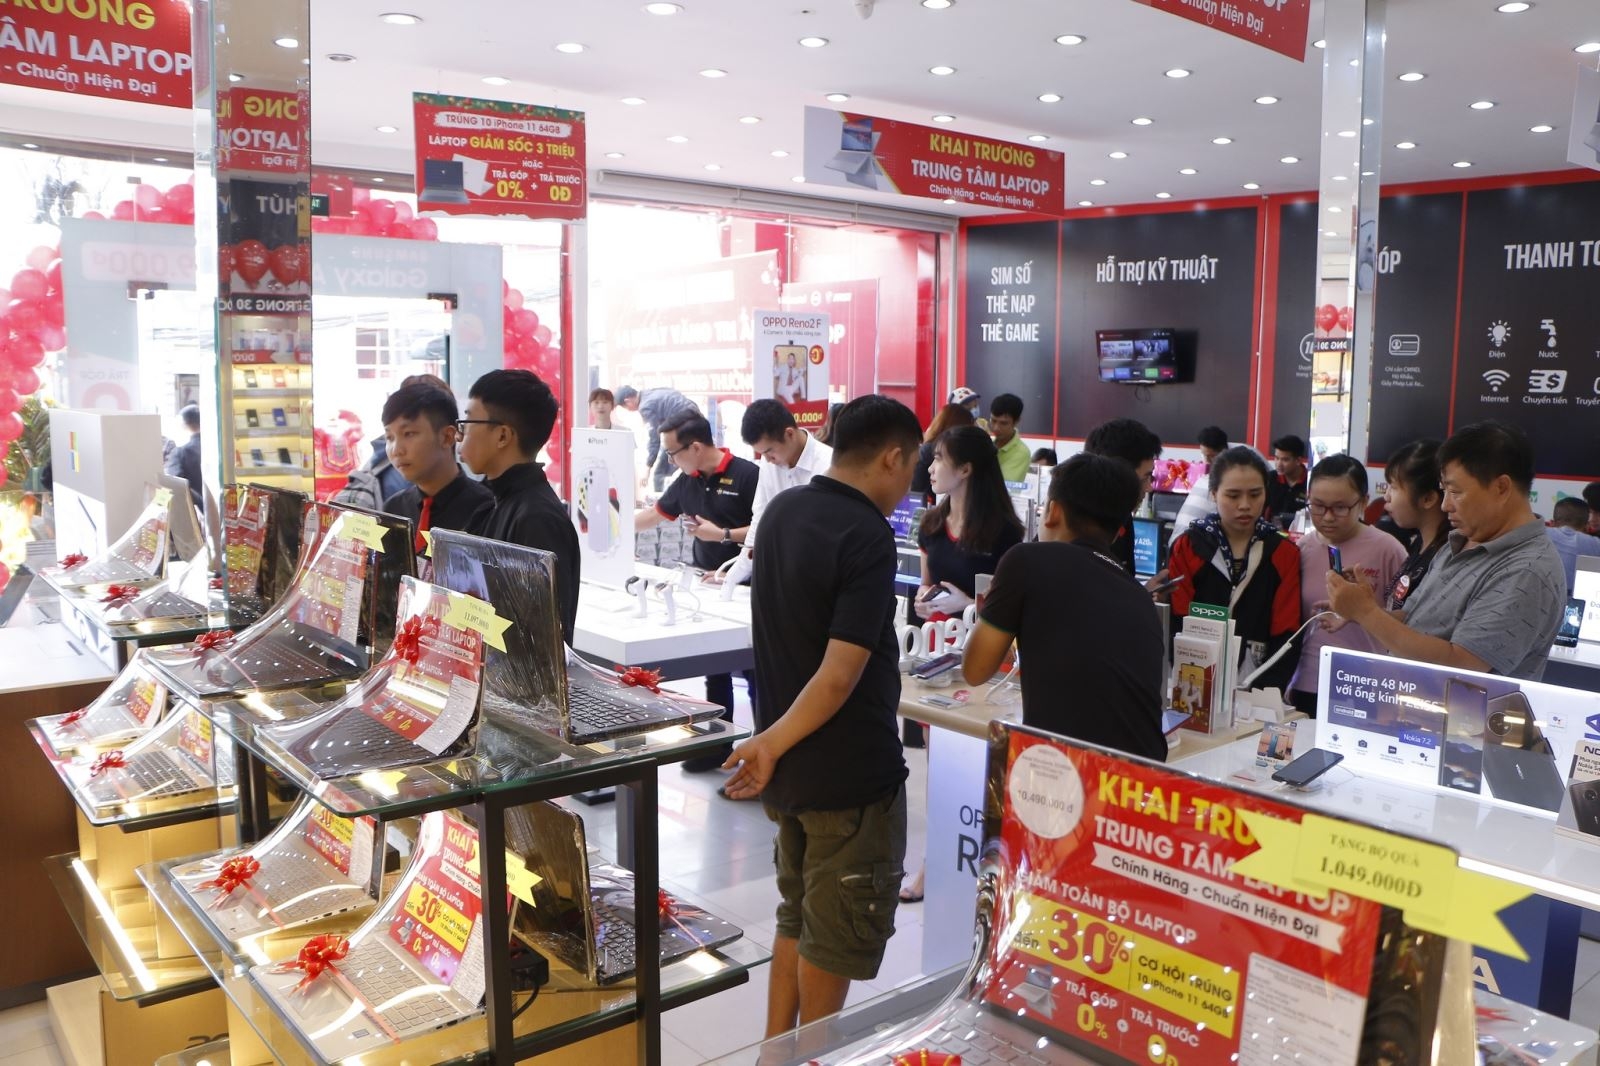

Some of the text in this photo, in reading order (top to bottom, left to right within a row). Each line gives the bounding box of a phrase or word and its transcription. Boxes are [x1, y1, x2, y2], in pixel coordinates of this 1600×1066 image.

[1247, 12, 1264, 35] Đại
[69, 34, 193, 76] LAPTOP
[16, 61, 157, 96] Chuẩn Hiện Đại
[481, 117, 492, 128] 10
[494, 118, 524, 131] iPhone
[428, 135, 467, 148] LAPTOP
[536, 142, 544, 154] 3
[930, 134, 1036, 168] KHAI TRƯƠNG
[496, 181, 524, 199] 0%
[911, 159, 1050, 196] TRUNG TÂM LAPTOP
[929, 182, 952, 196] Chính
[1096, 254, 1219, 286] HỖ TRỢ KỸ THUẬT
[1503, 241, 1575, 270] THANH
[990, 260, 1033, 285] SIM SỐ
[986, 290, 1036, 318] THẺ NẠP
[981, 318, 1039, 343] THẺ GAME
[1335, 684, 1352, 696] với
[1354, 685, 1376, 703] ống
[1336, 670, 1417, 693] Camera 48 MP
[1098, 771, 1180, 825] KHAI
[447, 825, 471, 853] KHAI
[1094, 816, 1174, 859] TRUNG
[1181, 841, 1236, 882] TÂM
[1319, 857, 1423, 898] 1.049.000Đ
[416, 890, 442, 923] 30%
[1060, 883, 1104, 911] TOÀN
[1107, 899, 1130, 923] BỘ
[1133, 909, 1197, 944] LAPTOP
[1111, 854, 1149, 878] Chính
[1201, 882, 1250, 915] Chuẩn
[1253, 900, 1288, 929] Hiện
[1292, 915, 1319, 940] Đại
[1048, 908, 1129, 975] 30%
[1064, 977, 1118, 1010] TRẢ GÓP
[1138, 953, 1233, 1003] CƠ HỘI TRÚNG
[1149, 976, 1184, 1000] iPhone
[1077, 1003, 1108, 1040] 0%
[1130, 1006, 1200, 1047] TRẢ TRƯỚC
